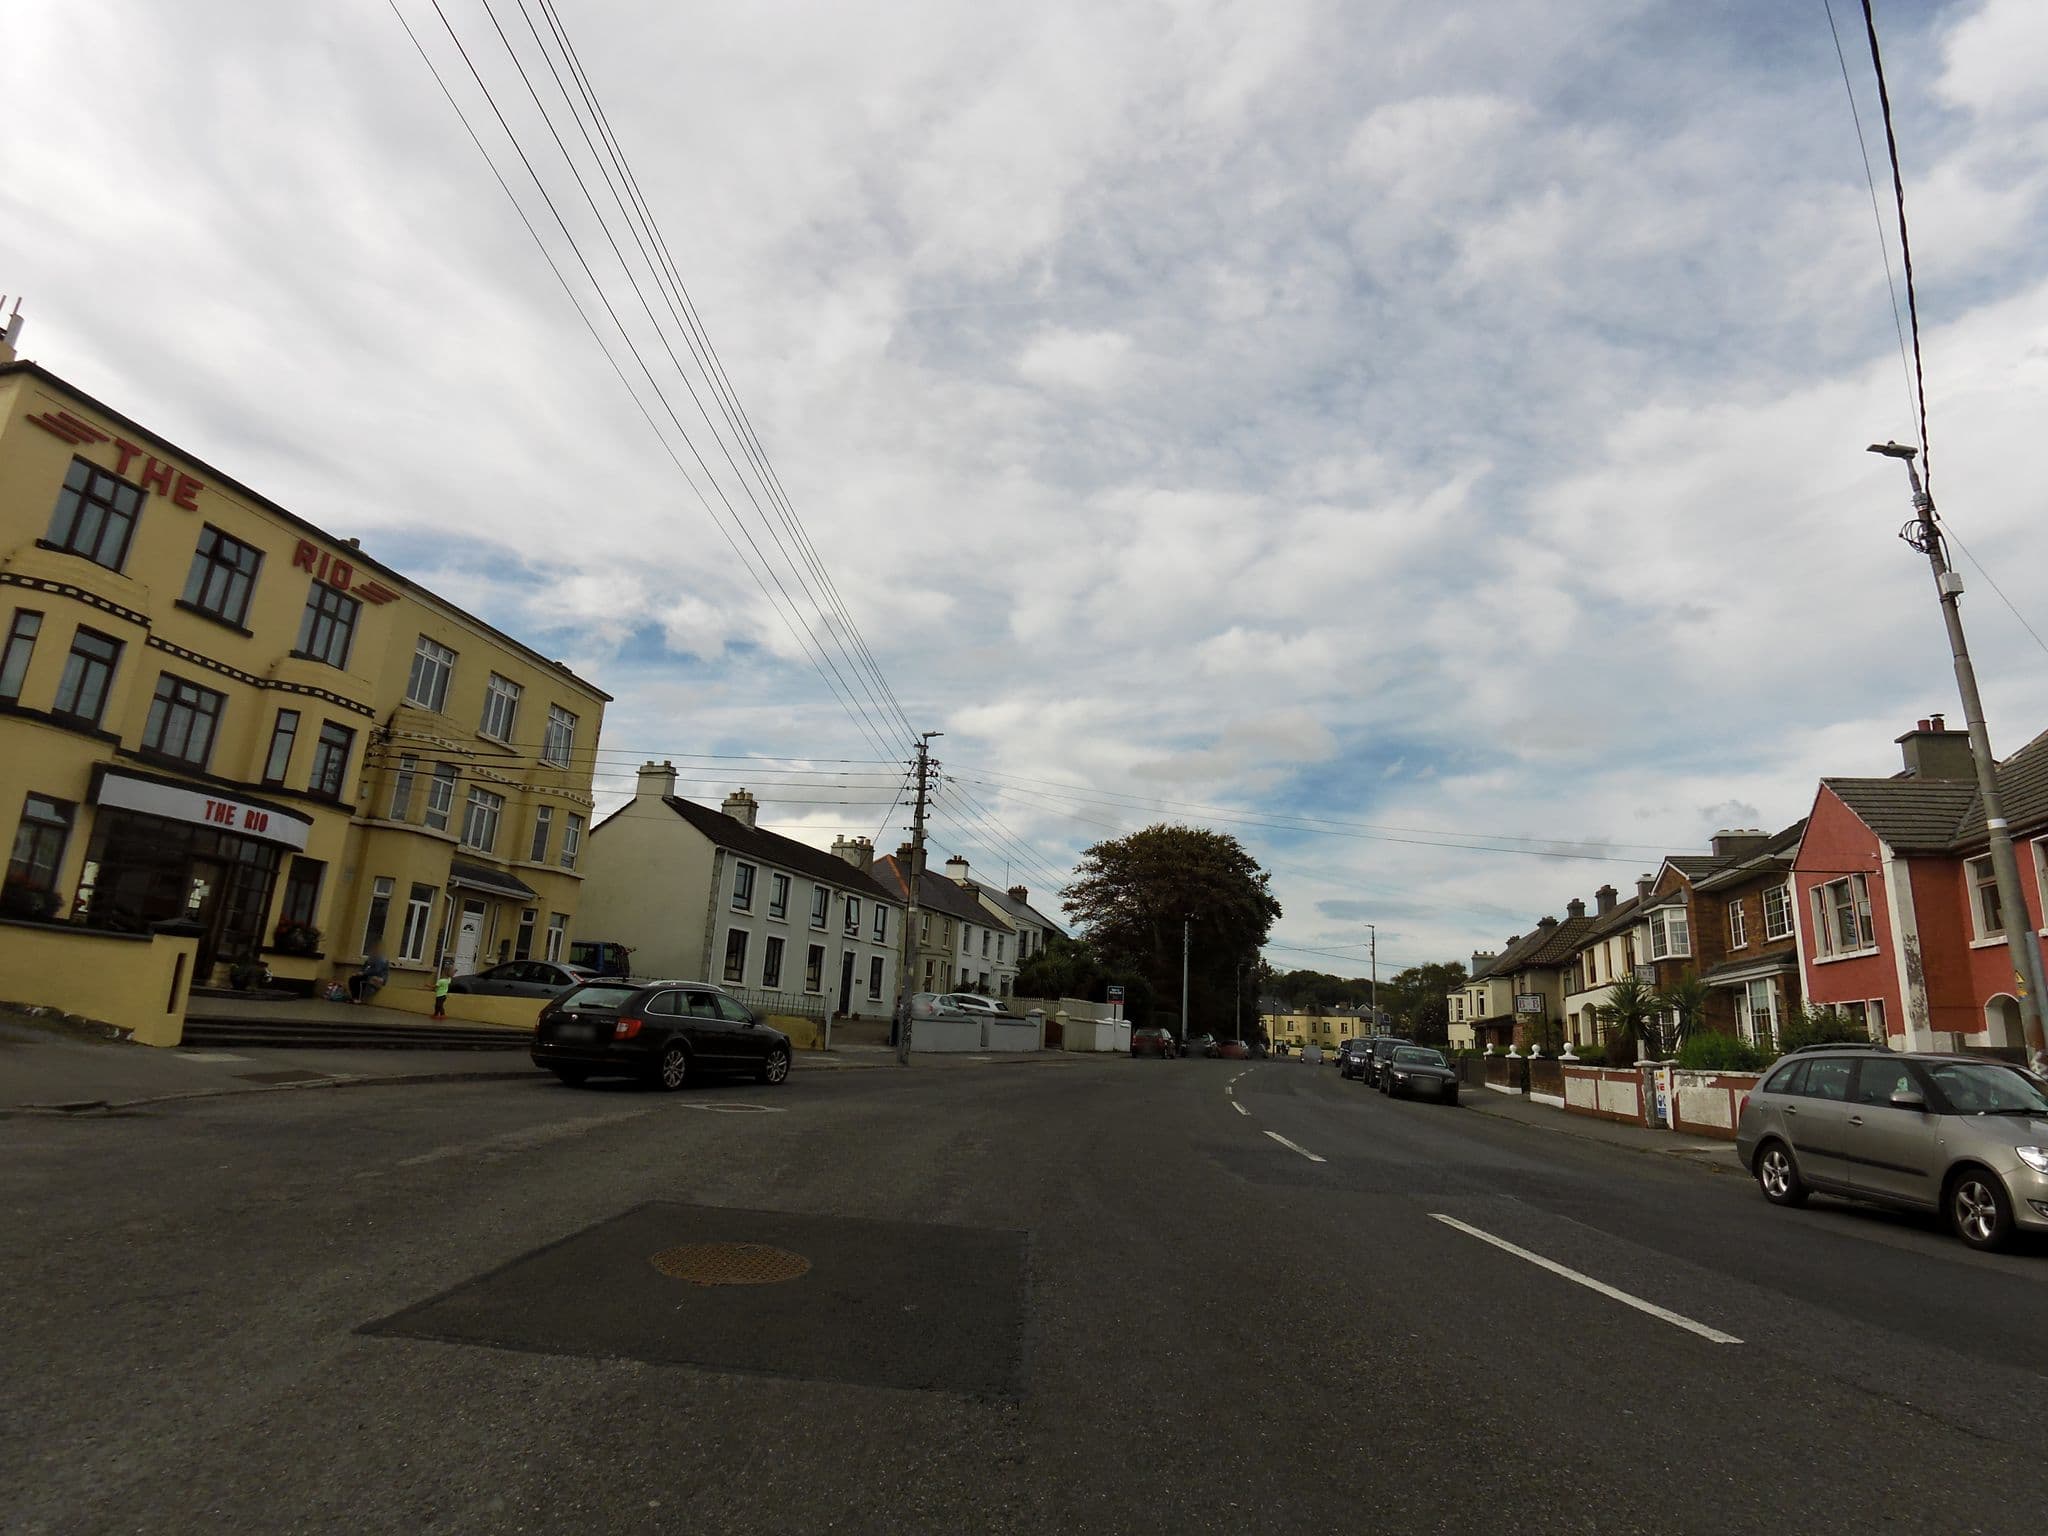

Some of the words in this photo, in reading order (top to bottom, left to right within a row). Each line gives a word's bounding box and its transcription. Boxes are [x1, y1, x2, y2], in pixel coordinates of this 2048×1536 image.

[116, 437, 203, 511] THE
[292, 537, 352, 590] RIO
[205, 800, 237, 825] THE
[244, 809, 268, 832] RIO
